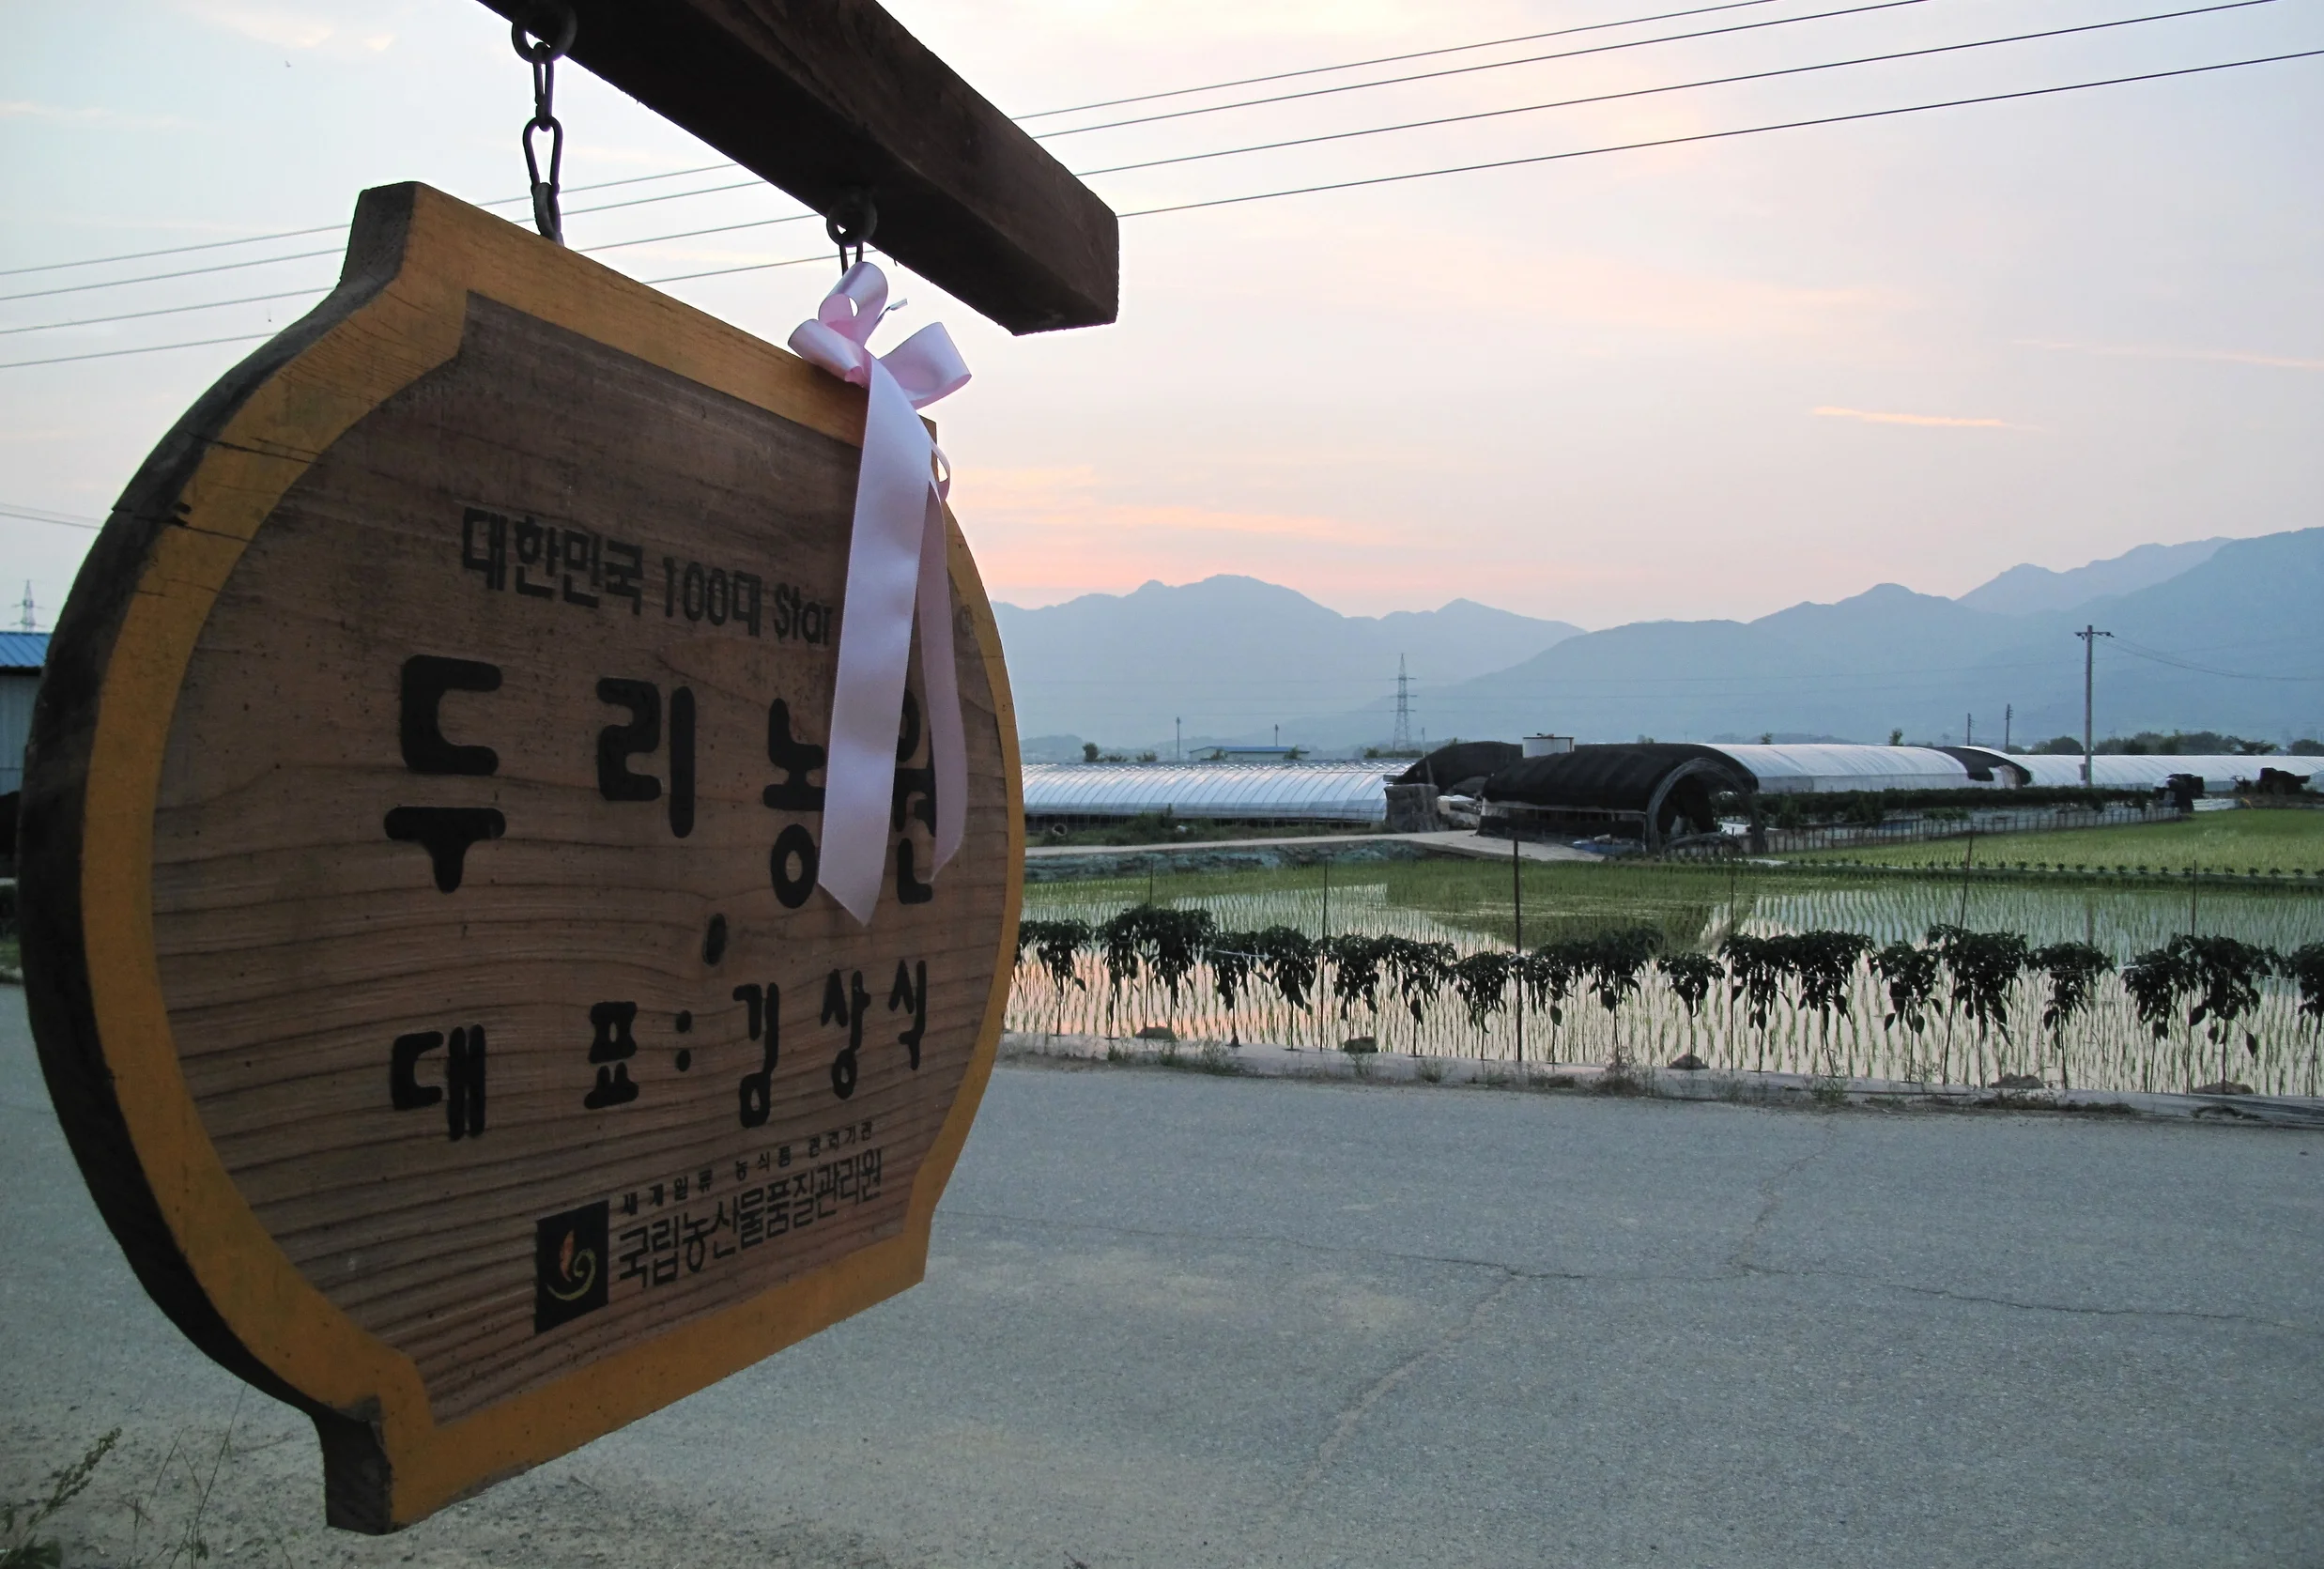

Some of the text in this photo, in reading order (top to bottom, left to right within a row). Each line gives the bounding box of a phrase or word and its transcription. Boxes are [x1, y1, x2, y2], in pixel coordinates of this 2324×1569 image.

[461, 505, 834, 646] 대한민국 100대 Star
[618, 1147, 884, 1288] 국립농산물품질관리원
